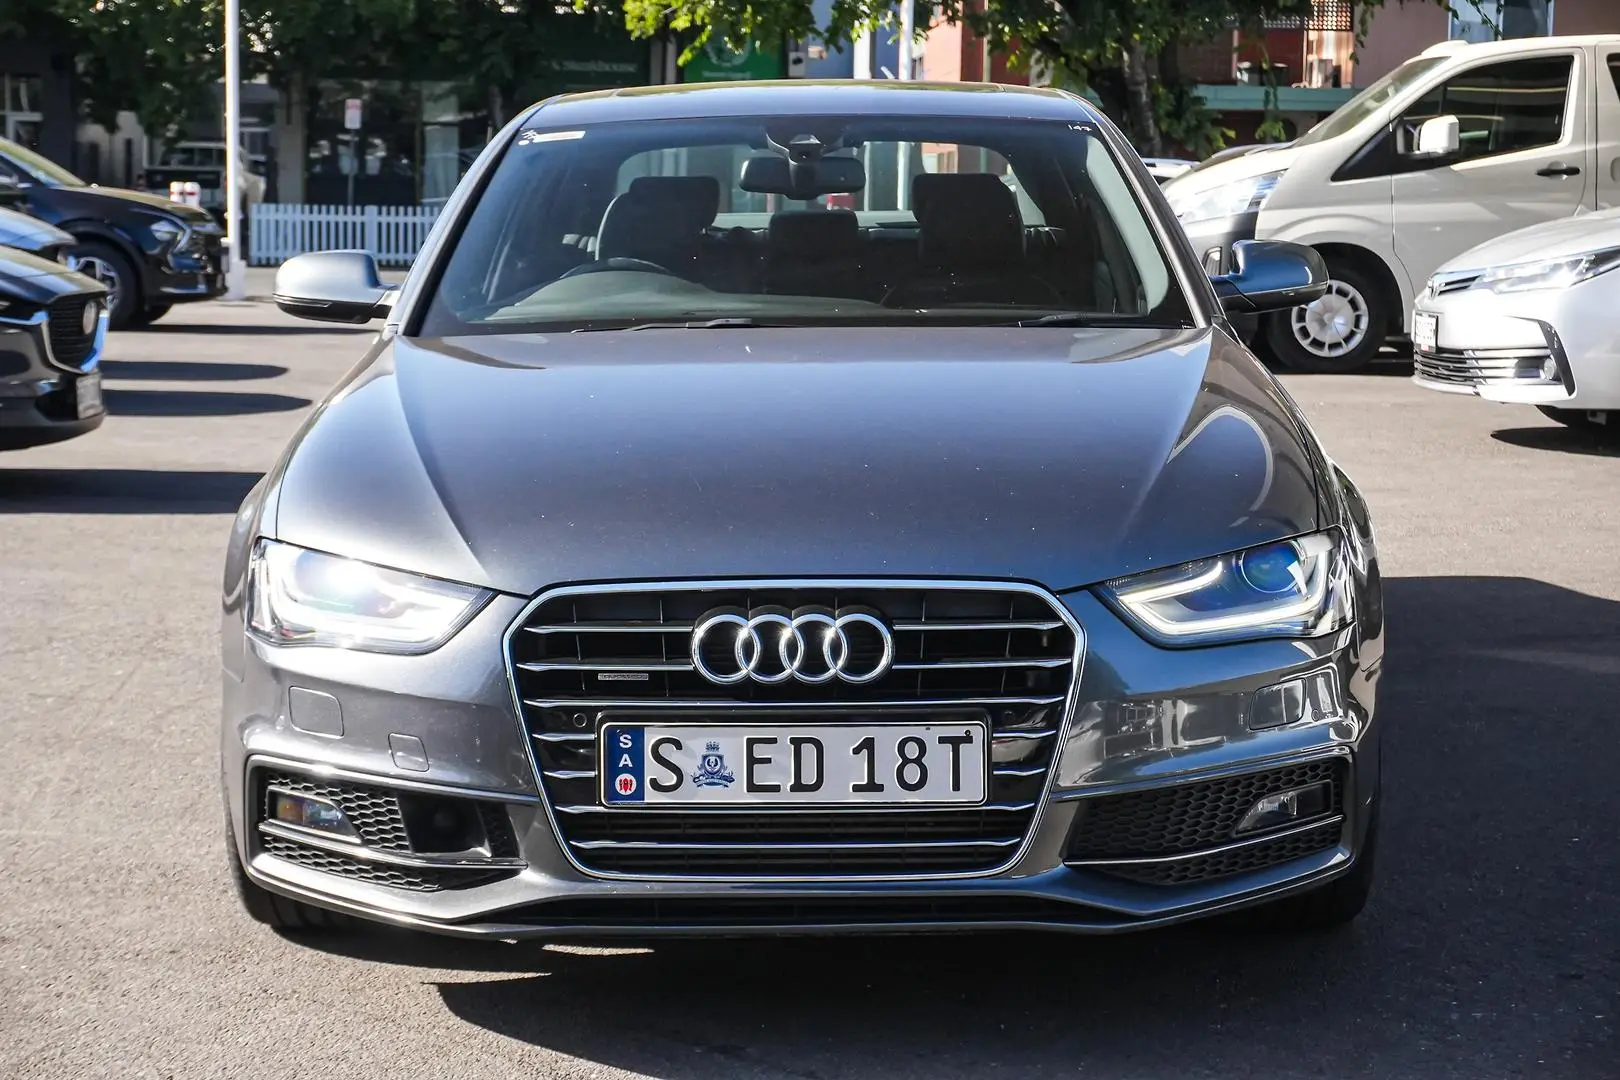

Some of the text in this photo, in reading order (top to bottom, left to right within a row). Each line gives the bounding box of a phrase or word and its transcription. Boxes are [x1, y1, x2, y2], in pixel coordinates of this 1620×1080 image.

[649, 735, 974, 793] S ED 18T
